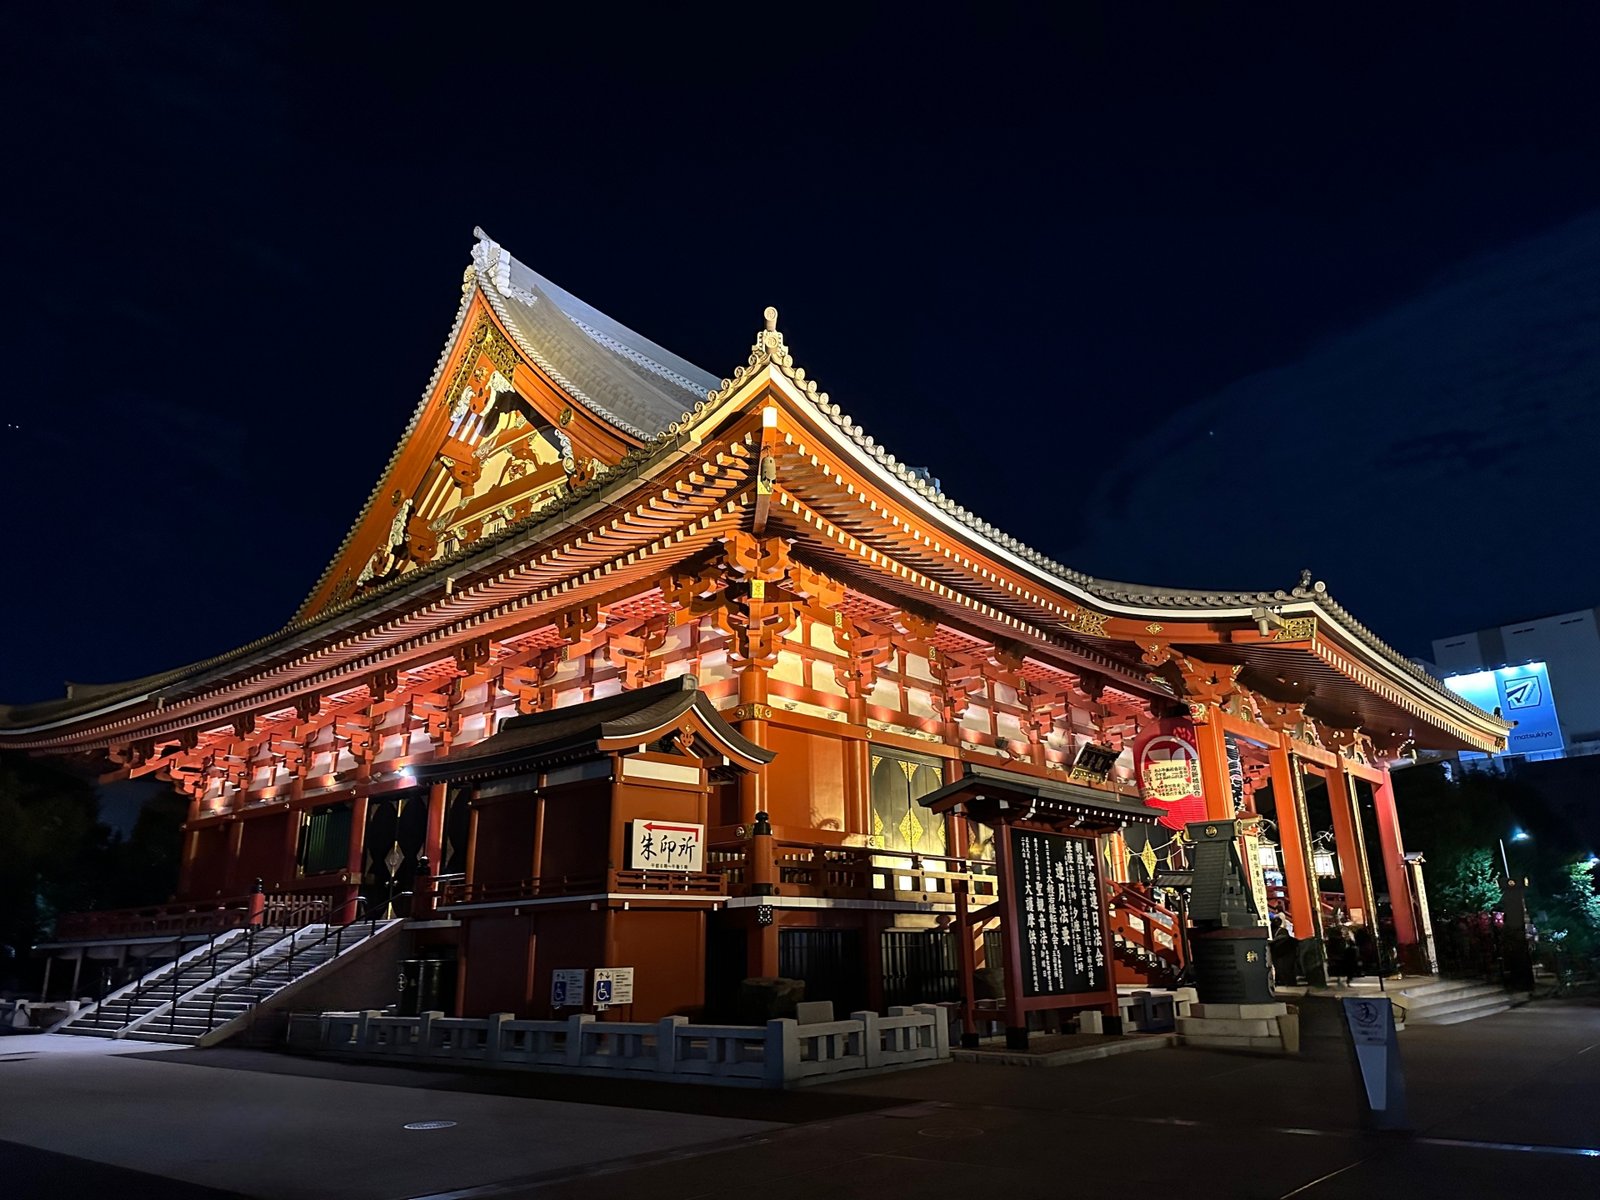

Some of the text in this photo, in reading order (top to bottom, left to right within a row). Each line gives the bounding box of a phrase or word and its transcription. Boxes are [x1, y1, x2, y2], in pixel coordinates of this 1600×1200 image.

[1514, 730, 1553, 740] matsukiyo
[640, 832, 696, 864] 朱印所
[1024, 880, 1037, 945] 大護摩供
[1034, 881, 1049, 944] 聖観音法
[1054, 861, 1071, 946] 連月法要
[1085, 851, 1104, 967] 本堂連日法会
